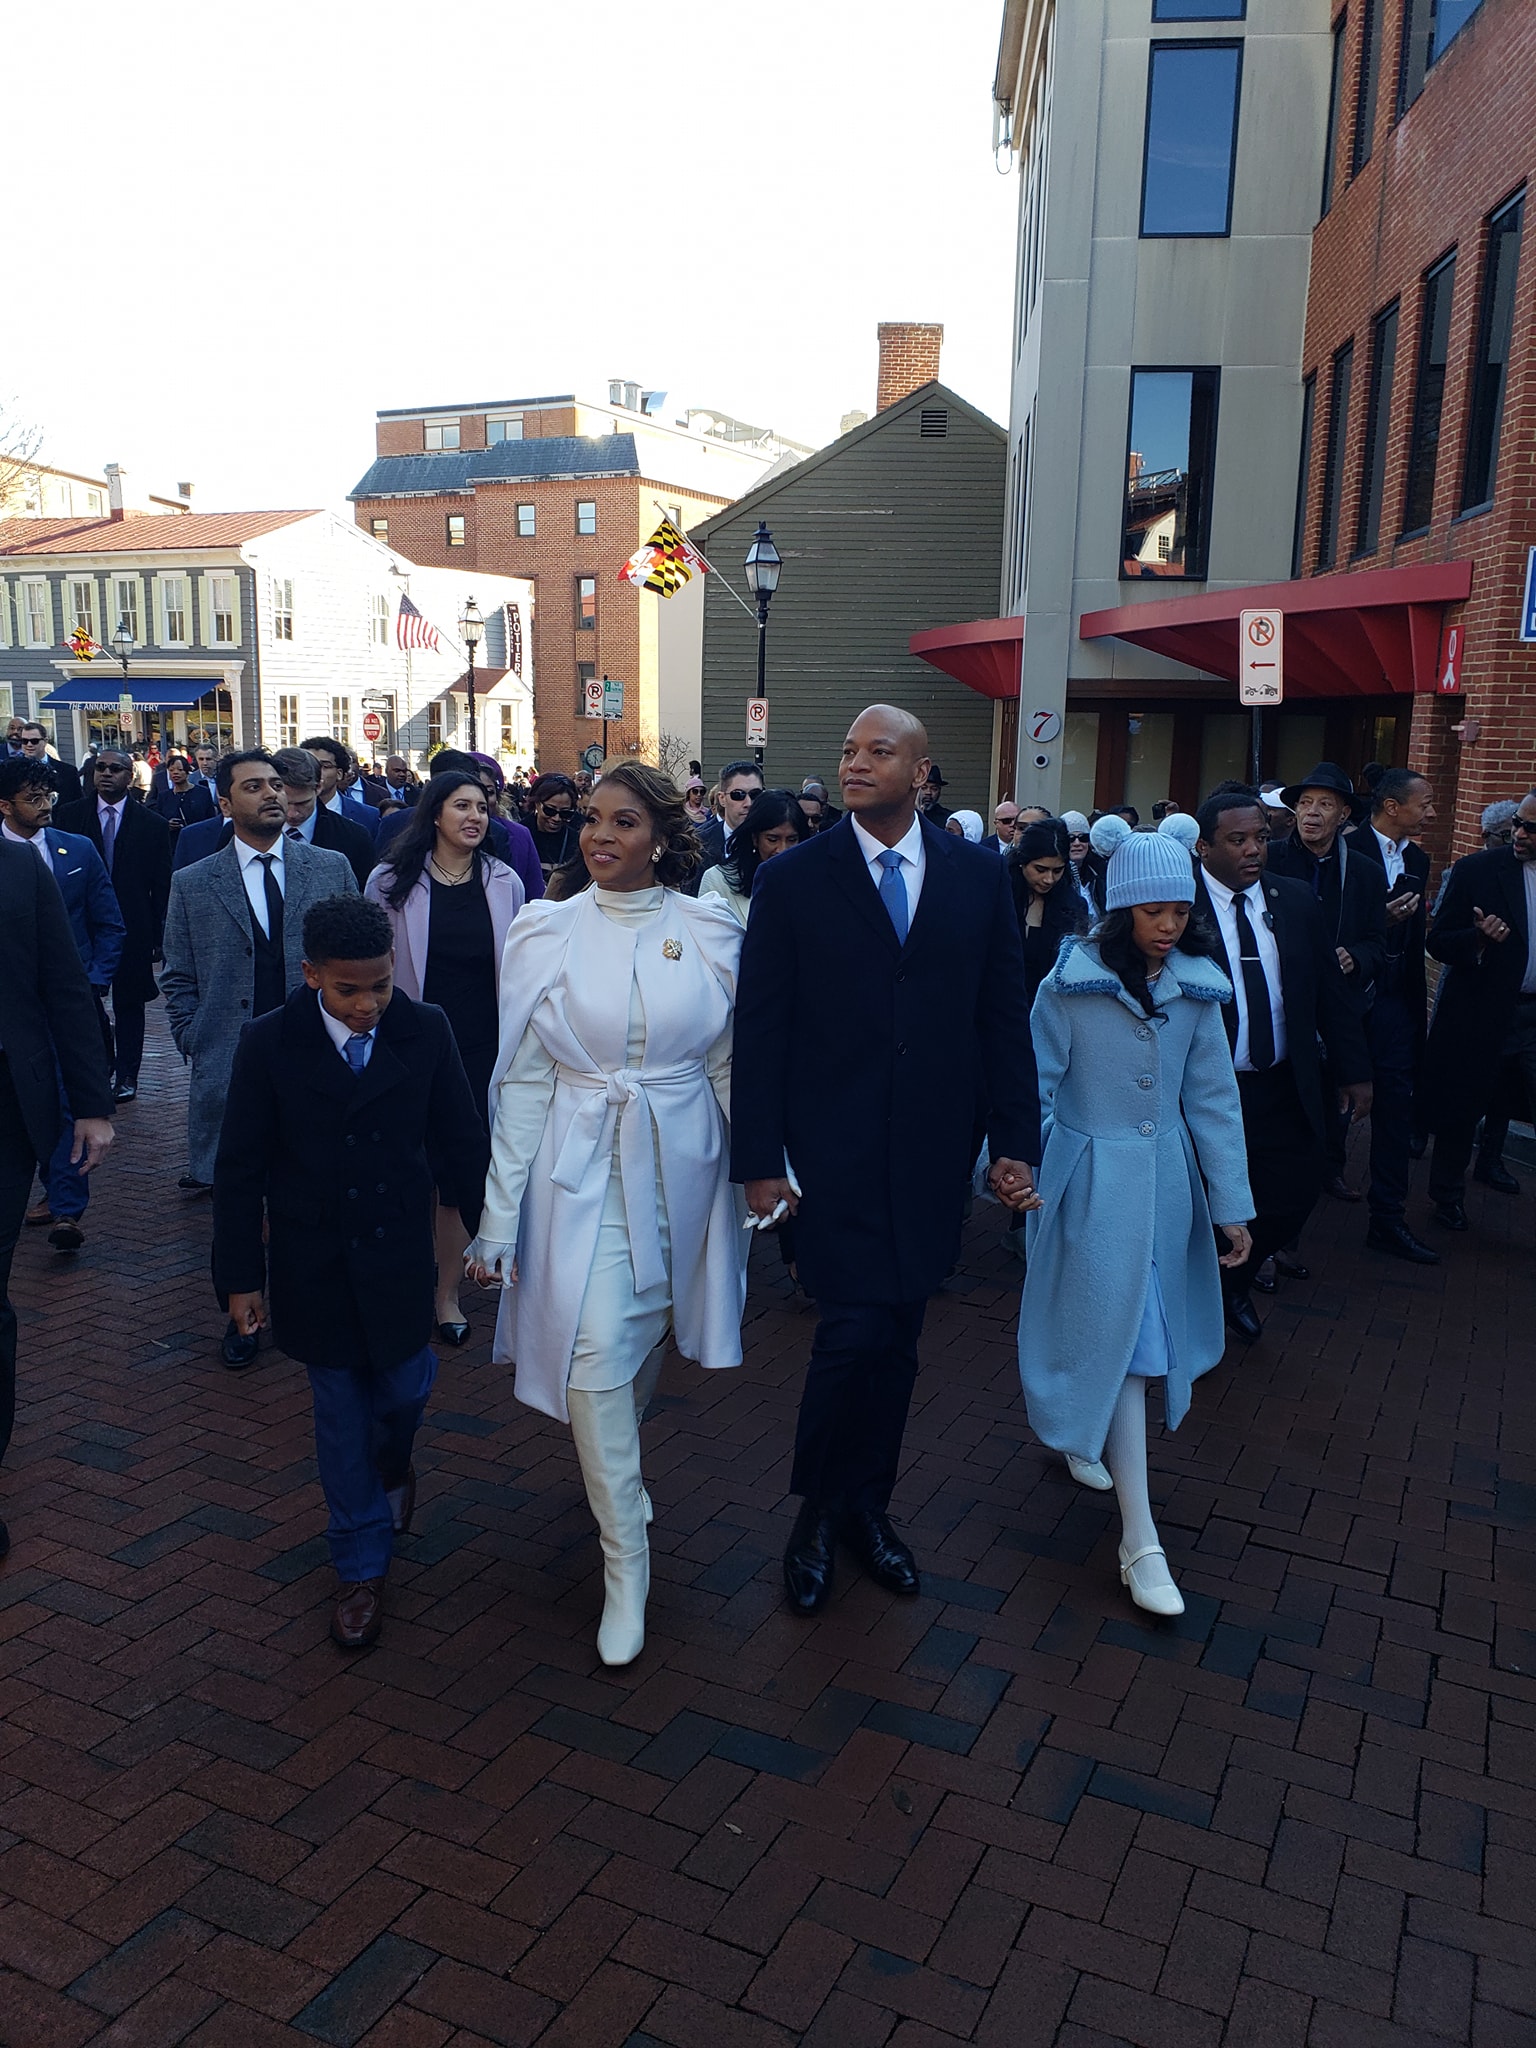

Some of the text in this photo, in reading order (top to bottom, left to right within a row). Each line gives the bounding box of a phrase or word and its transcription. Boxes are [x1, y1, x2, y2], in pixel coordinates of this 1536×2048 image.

[513, 612, 521, 676] POTTER
[84, 703, 120, 711] ANNAPOLI
[131, 704, 159, 712] OTTERY
[1033, 711, 1054, 738] 7
